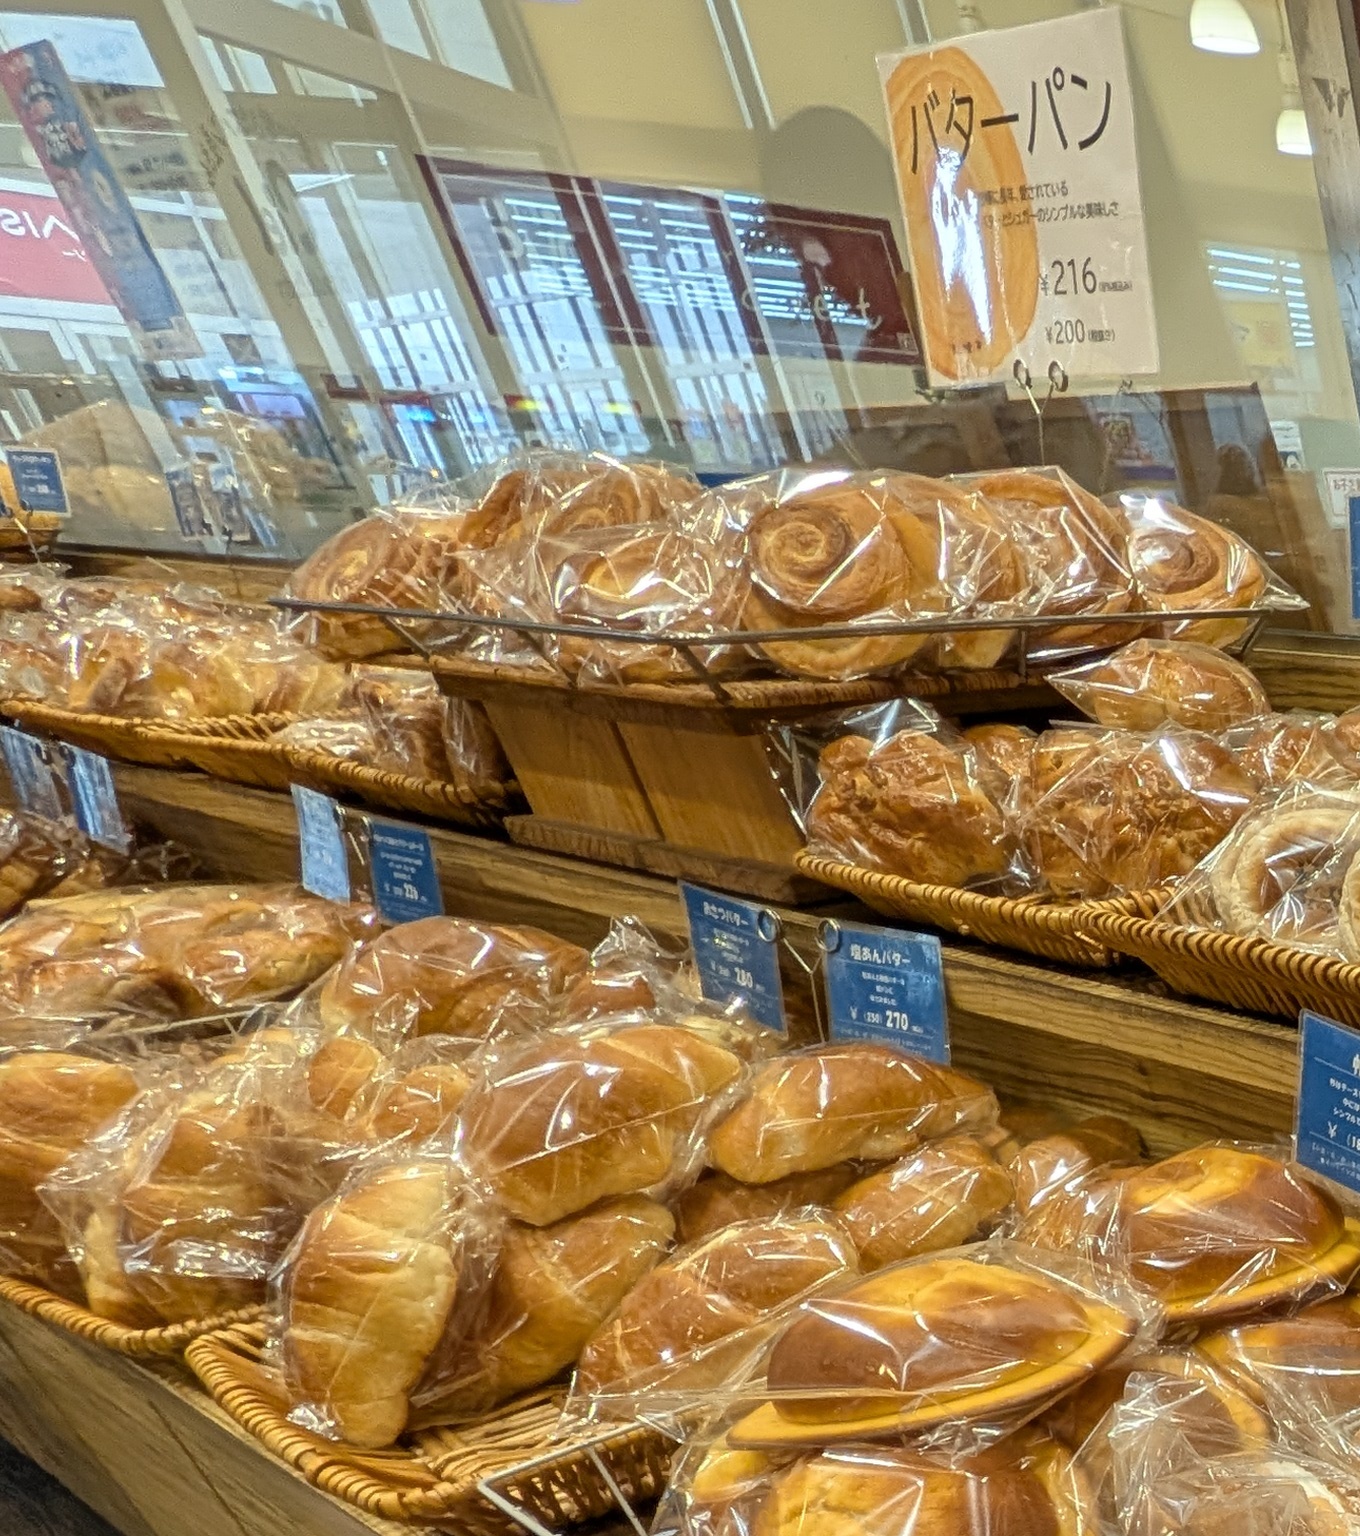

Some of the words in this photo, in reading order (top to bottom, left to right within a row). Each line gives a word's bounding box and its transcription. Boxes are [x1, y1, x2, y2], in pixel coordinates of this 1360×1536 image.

[911, 66, 1112, 174] バターパン
[885, 1009, 909, 1031] 270
[1327, 1120, 1338, 1139] ¥
